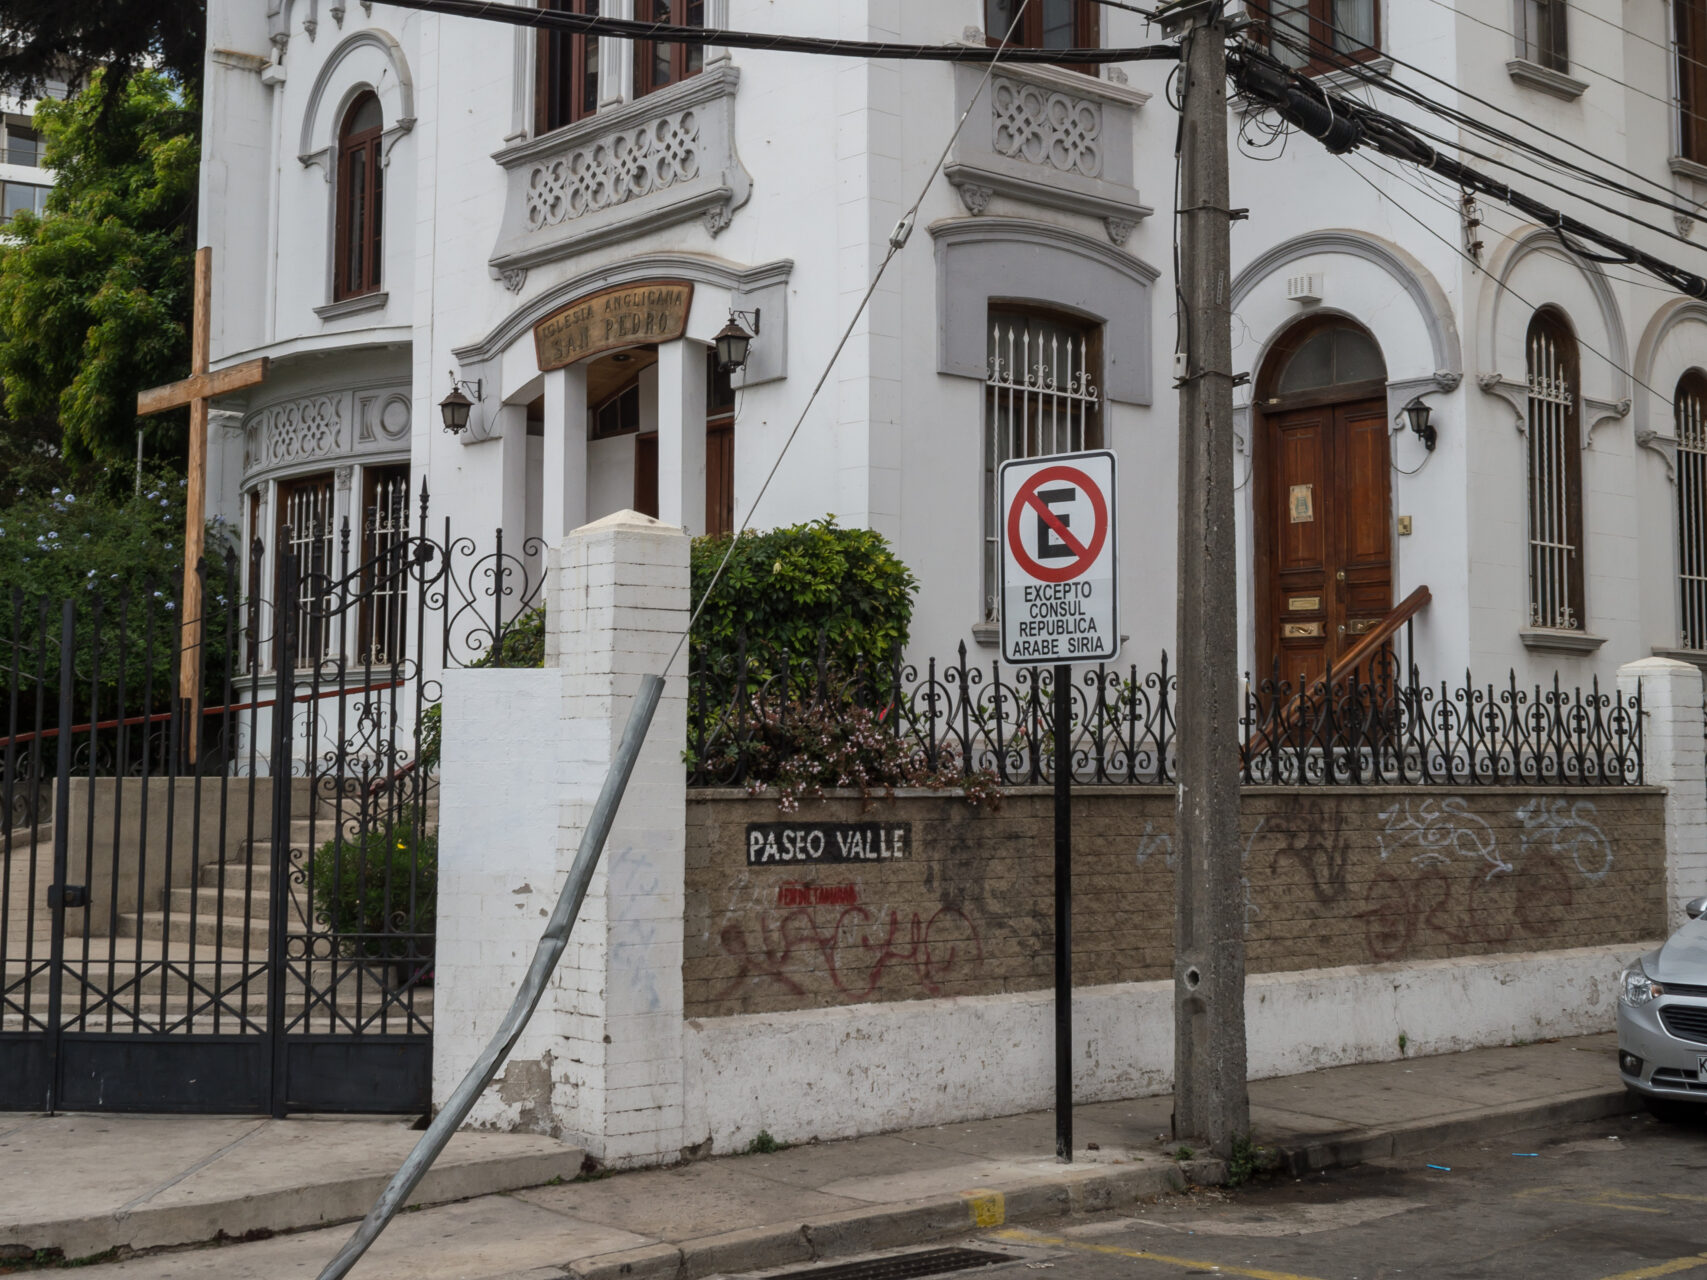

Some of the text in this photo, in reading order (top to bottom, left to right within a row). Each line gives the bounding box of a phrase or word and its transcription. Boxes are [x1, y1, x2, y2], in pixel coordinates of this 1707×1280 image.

[541, 287, 682, 340] IGLESIA ANGLICANA
[551, 311, 668, 359] SAN PEDRO
[1037, 487, 1077, 559] E
[1024, 581, 1092, 602] EXCEPTO
[1029, 600, 1086, 619] CONSUL
[1019, 617, 1097, 637] REPUBLICA
[1012, 636, 1104, 656] ARABE SIRIA
[750, 829, 904, 862] PASEO VALLE
